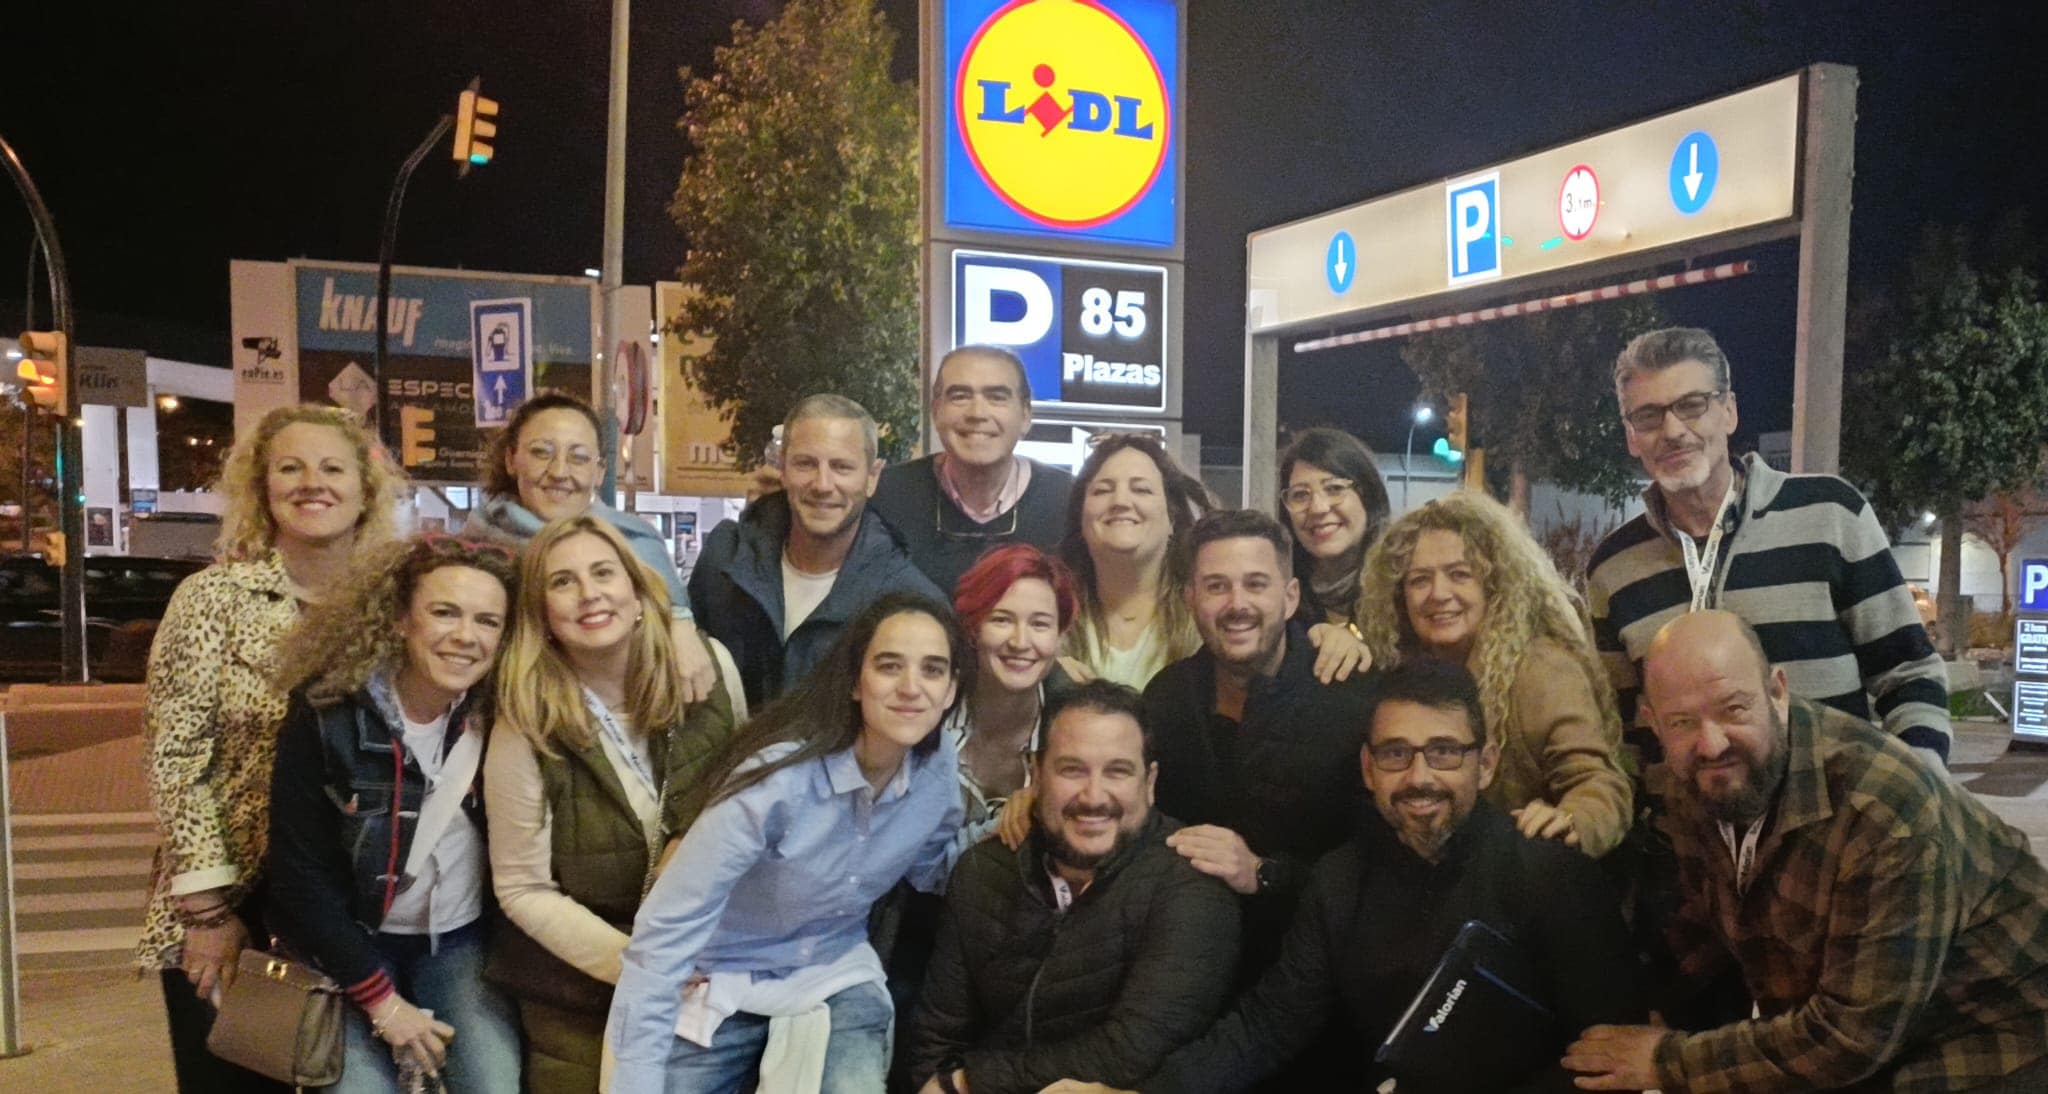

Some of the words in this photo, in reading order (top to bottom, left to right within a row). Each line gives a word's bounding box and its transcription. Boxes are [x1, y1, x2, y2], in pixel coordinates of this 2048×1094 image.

[1455, 189, 1490, 274] P
[964, 264, 1053, 347] P
[1080, 287, 1147, 338] 85
[1062, 352, 1162, 386] Plazas
[2025, 564, 2048, 605] P
[1423, 978, 1468, 1032] Valorian
